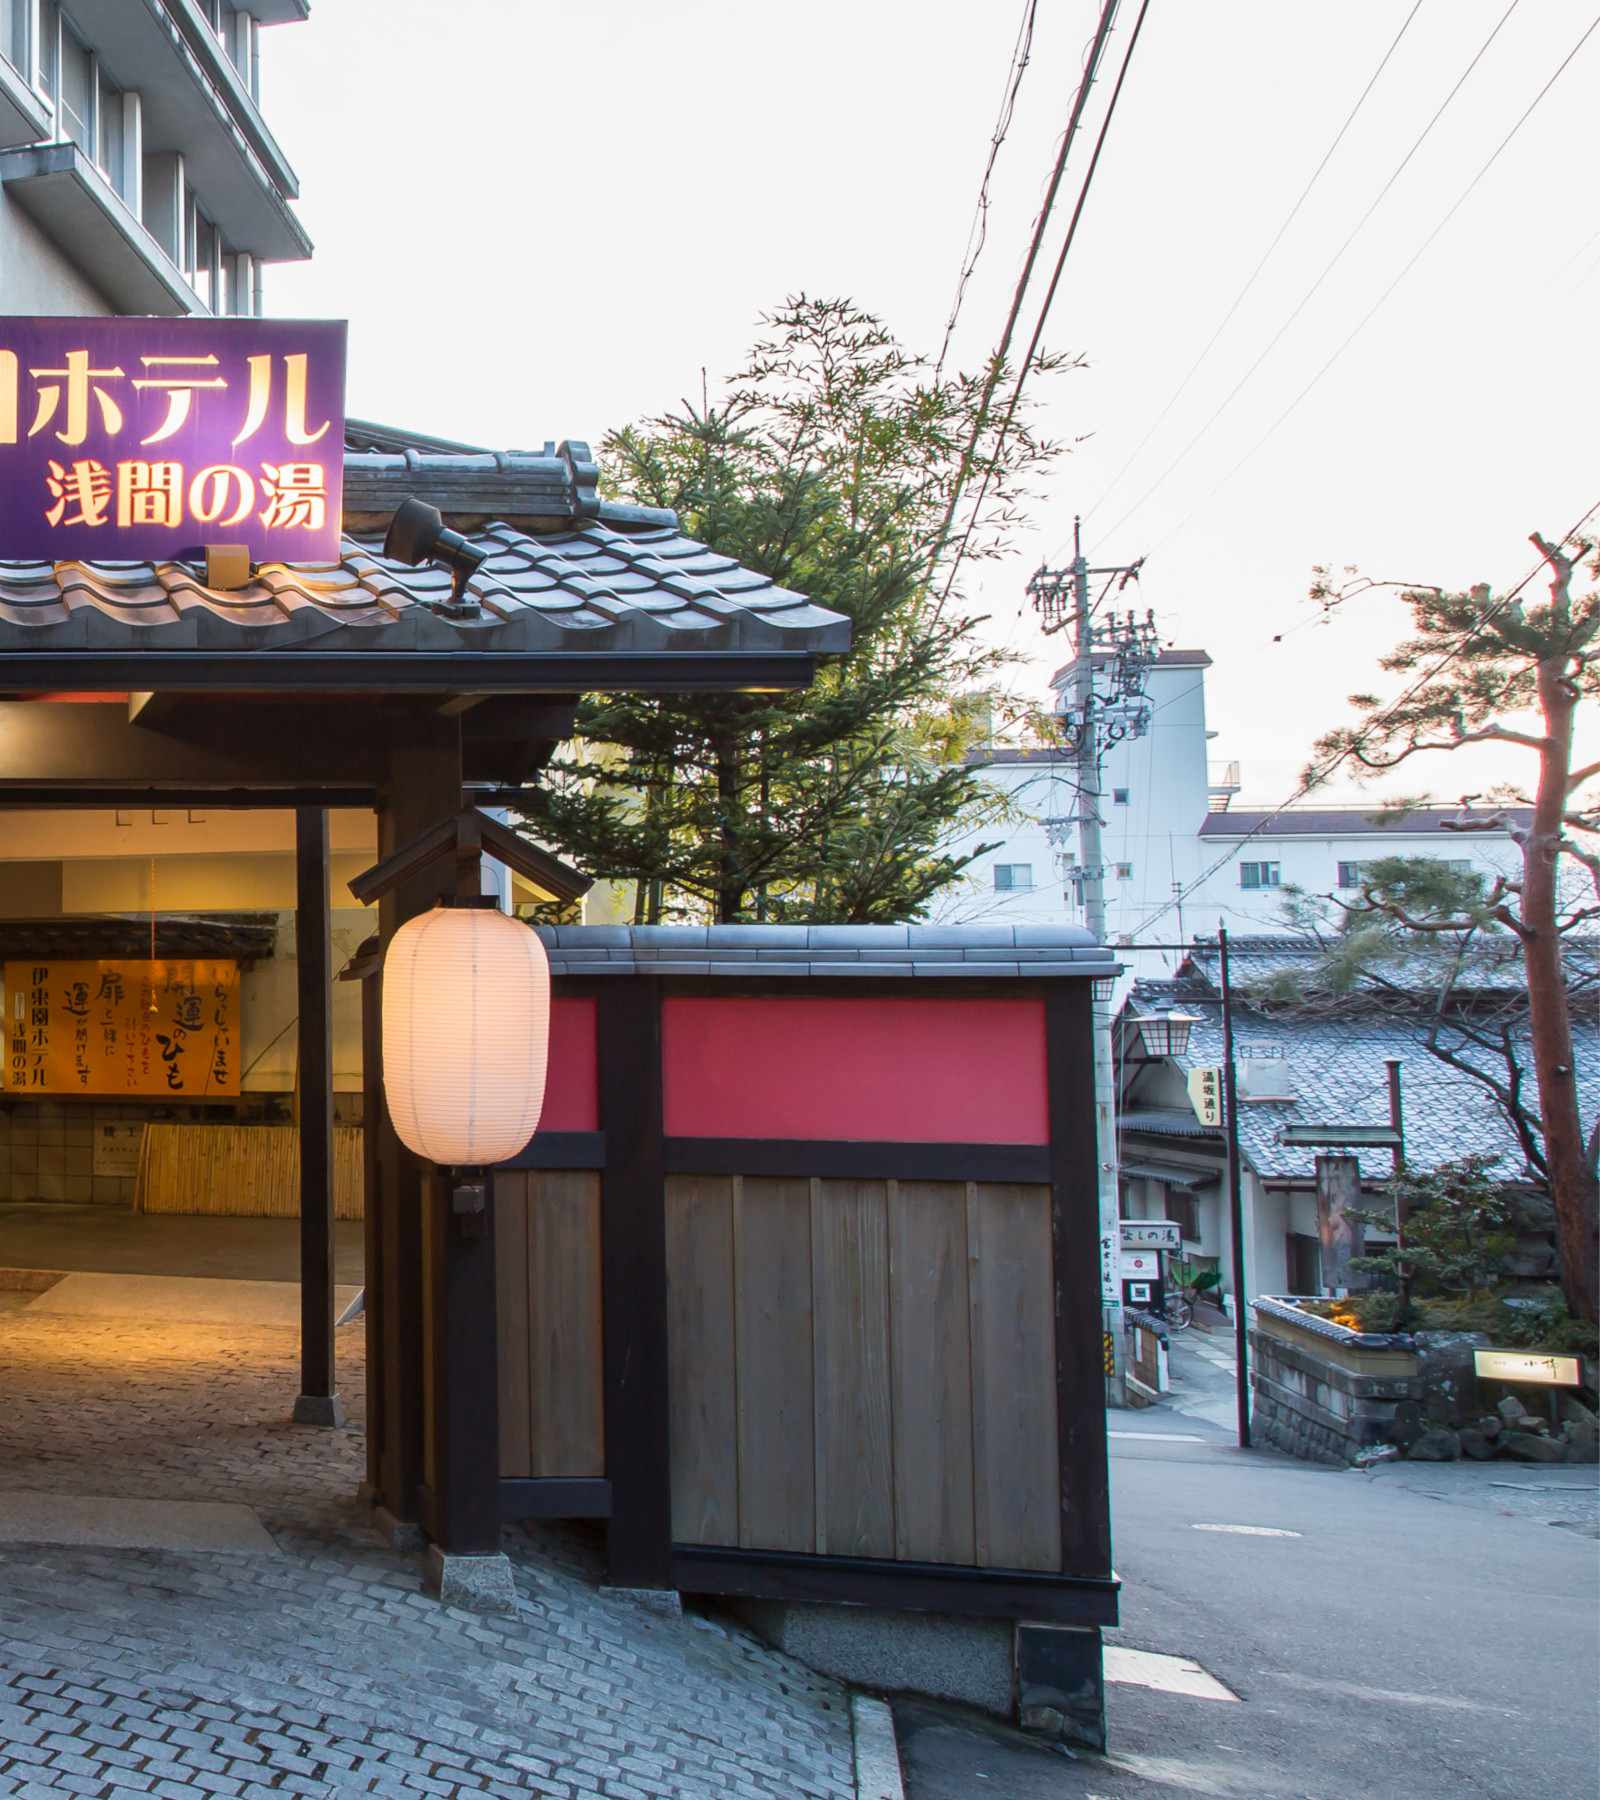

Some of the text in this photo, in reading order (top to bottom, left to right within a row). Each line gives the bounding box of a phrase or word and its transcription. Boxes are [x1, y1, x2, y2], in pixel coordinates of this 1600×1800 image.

[44, 458, 329, 531] 浅間の湯
[12, 1022, 26, 1087] 浅間の湯
[31, 967, 49, 1087] 伊東園ホテル
[94, 966, 125, 1057] 扉と一緒に
[155, 966, 205, 1090] 開運のひも
[212, 966, 230, 1085] いらっしゃいませ
